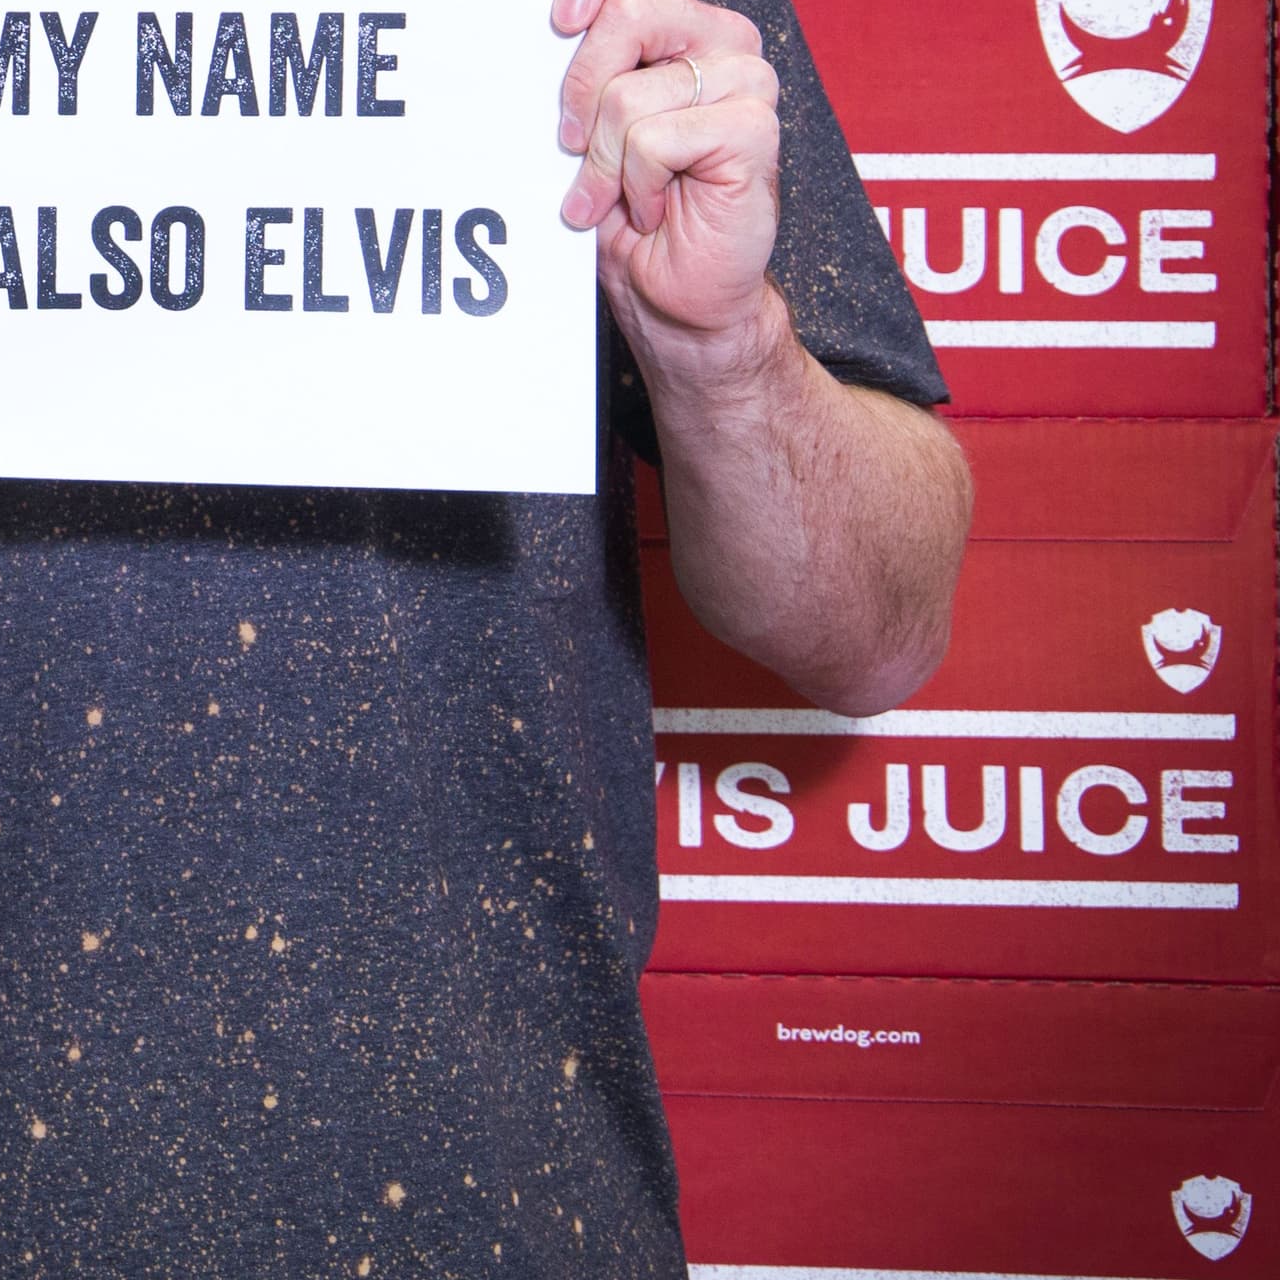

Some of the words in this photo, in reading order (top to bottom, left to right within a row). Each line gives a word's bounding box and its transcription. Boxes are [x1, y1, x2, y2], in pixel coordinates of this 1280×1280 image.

[136, 12, 406, 117] NAME
[245, 208, 507, 316] ELVIS
[873, 206, 1217, 296] UICE
[656, 763, 794, 849] IS
[848, 764, 1238, 855] JUICE
[777, 1023, 920, 1047] brewdog.com
